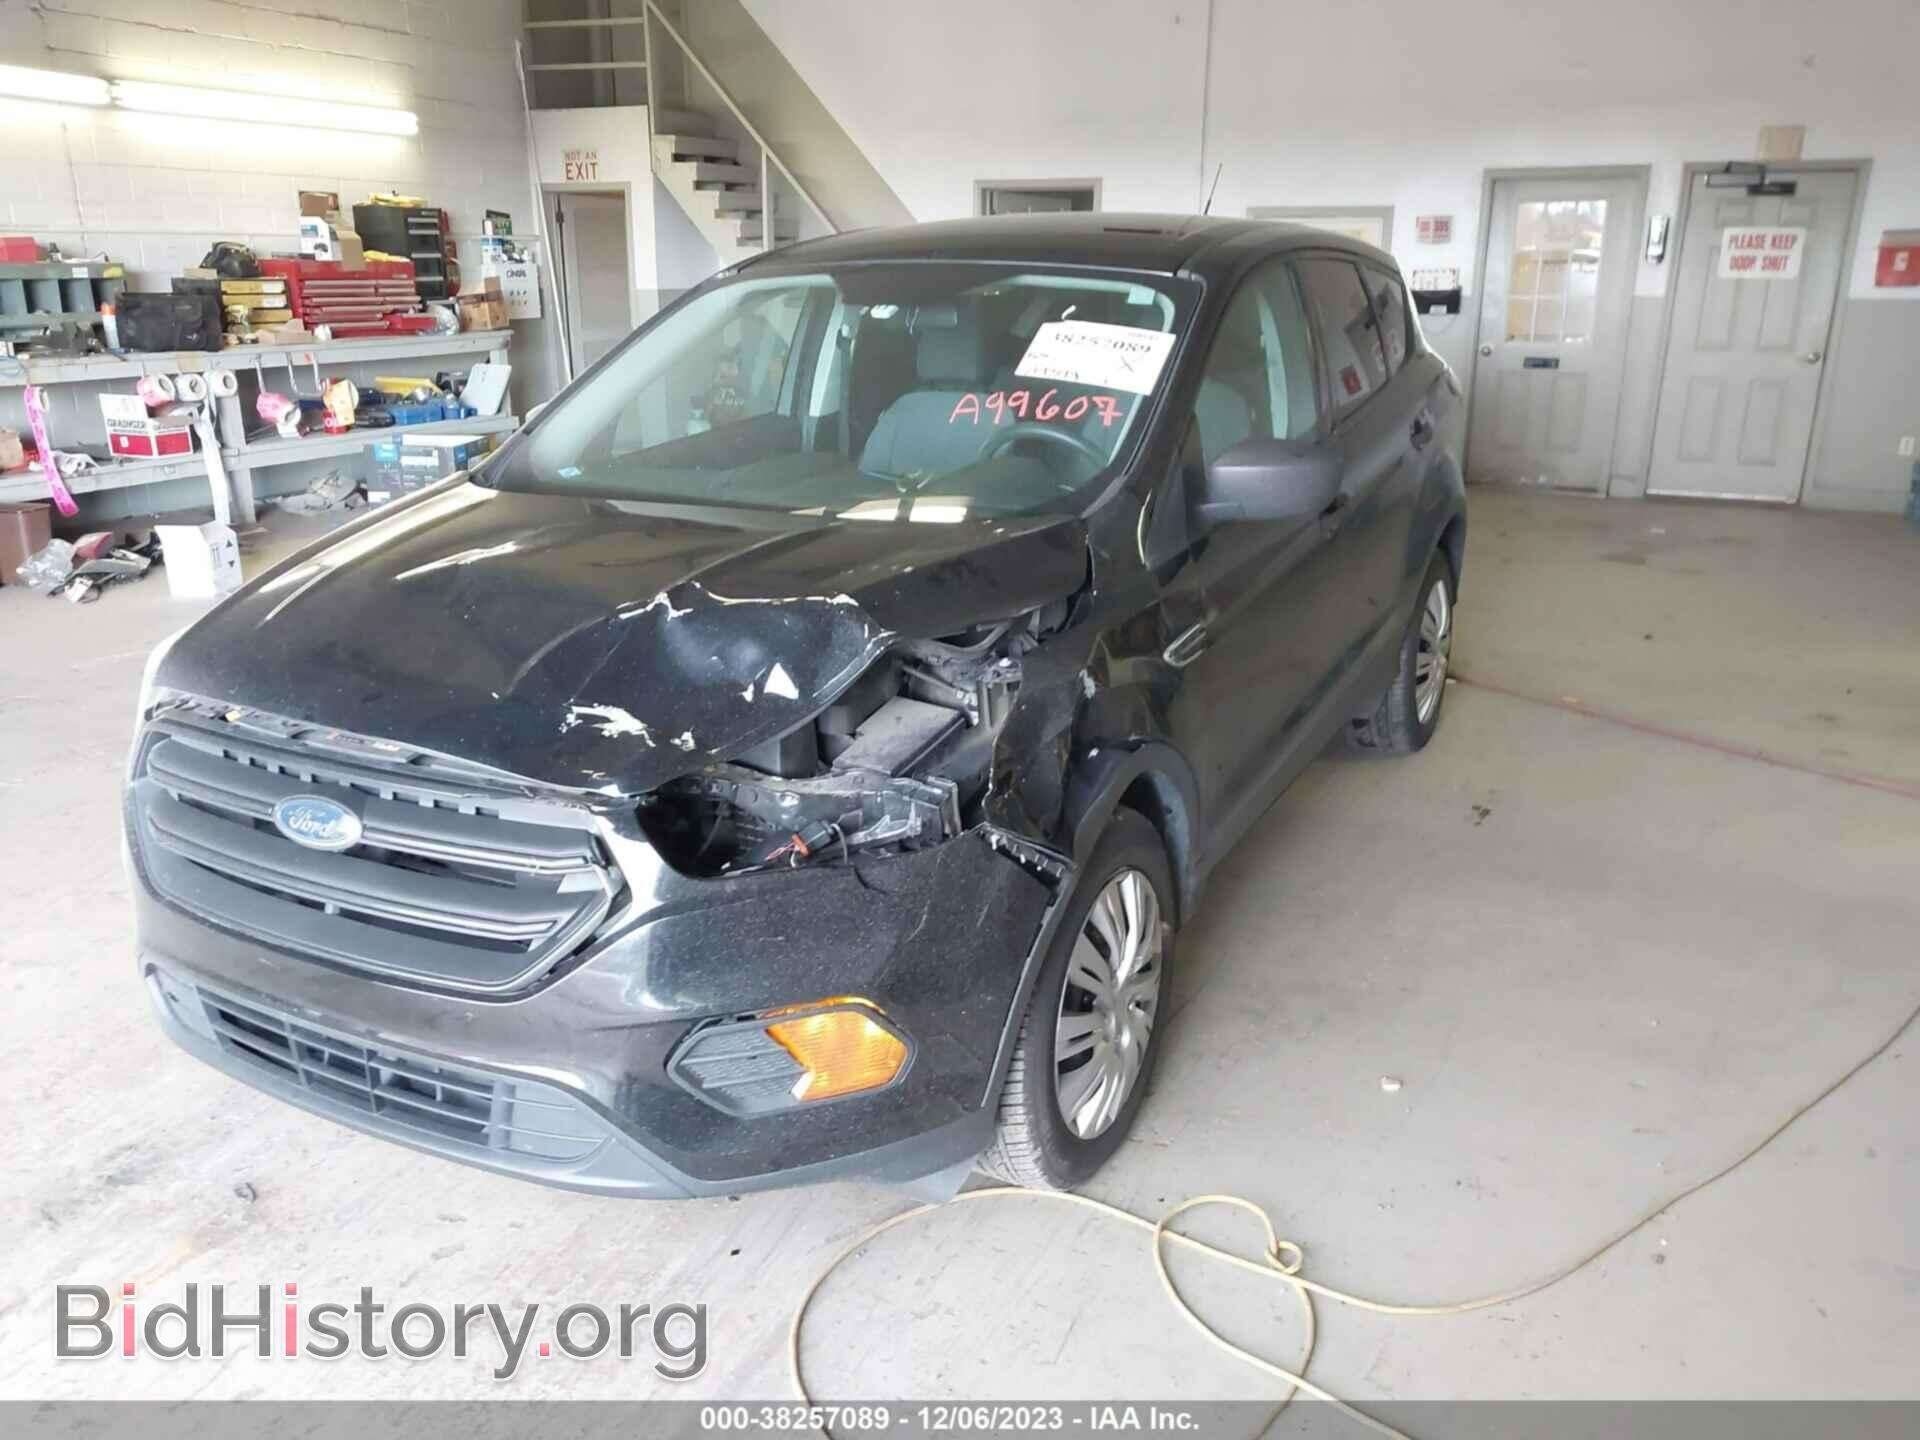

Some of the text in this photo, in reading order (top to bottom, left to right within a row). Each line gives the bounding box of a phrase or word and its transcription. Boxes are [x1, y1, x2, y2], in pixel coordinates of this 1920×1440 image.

[564, 151, 598, 161] NOT AN
[565, 162, 598, 181] EXIT
[1728, 233, 1799, 250] PLEASE KEEP
[949, 388, 1123, 427] A99607
[287, 806, 343, 837] Ford
